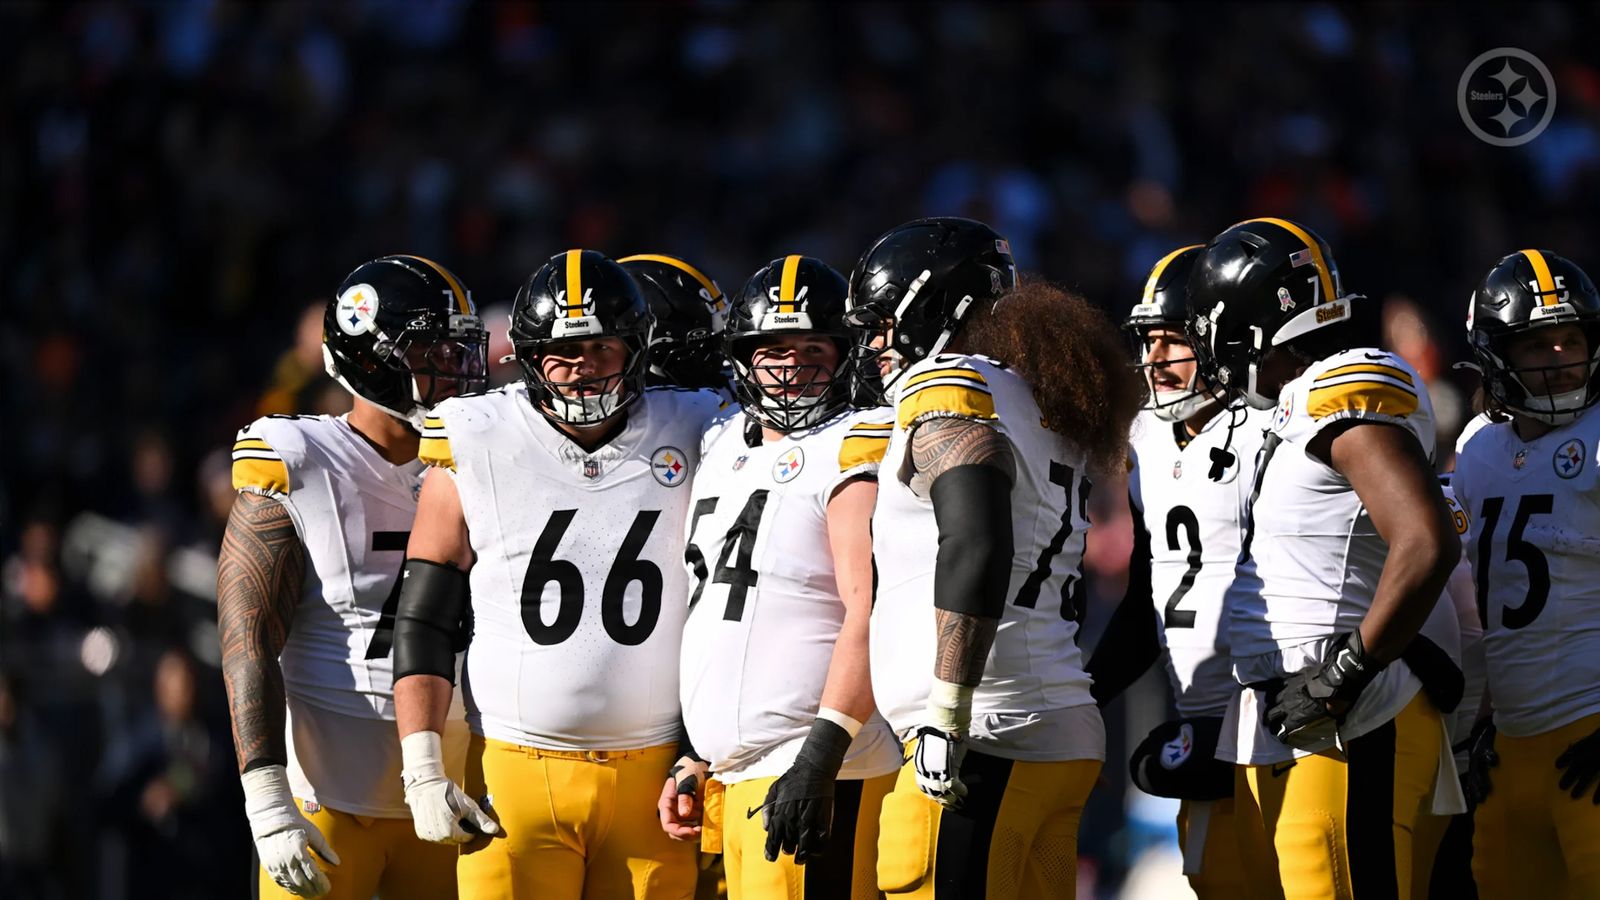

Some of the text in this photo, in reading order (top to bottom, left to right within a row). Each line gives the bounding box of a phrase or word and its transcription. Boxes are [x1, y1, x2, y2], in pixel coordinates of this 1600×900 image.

[555, 288, 596, 319] 66
[564, 320, 589, 329] Steelers
[774, 315, 799, 324] Steelers
[1529, 276, 1570, 307] 15
[520, 508, 664, 646] 66
[684, 489, 770, 623] 54
[1164, 505, 1203, 629] 2
[1477, 494, 1554, 631] 15
